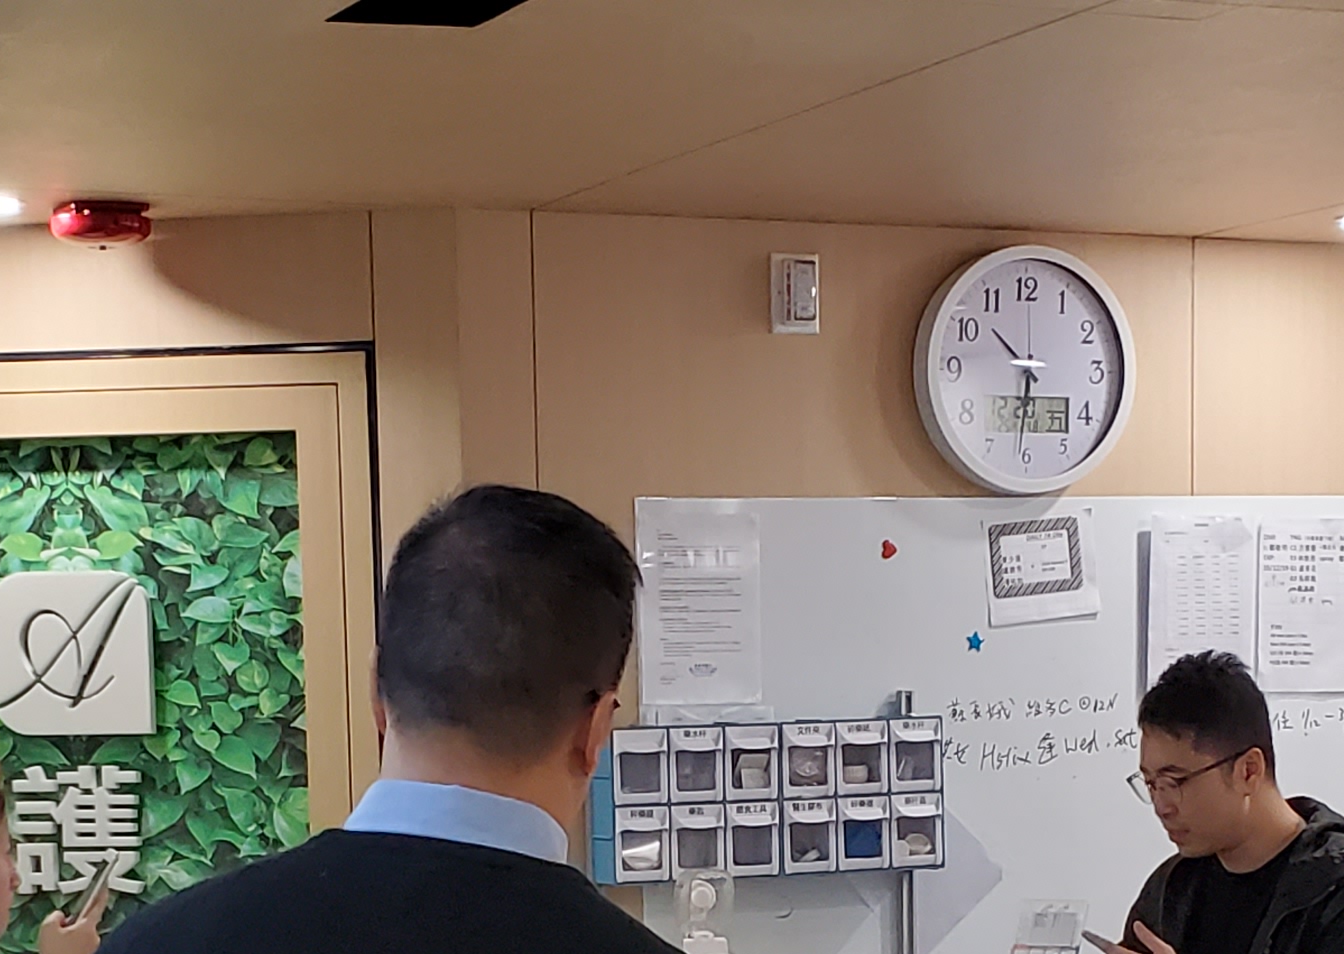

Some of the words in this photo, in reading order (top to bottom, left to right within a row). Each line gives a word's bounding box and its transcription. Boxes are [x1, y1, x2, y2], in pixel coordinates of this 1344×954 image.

[984, 288, 1000, 313] 11
[1016, 277, 1038, 302] 12
[1058, 290, 1066, 314] 1
[958, 317, 979, 342] 10
[1081, 320, 1095, 344] 2
[947, 356, 962, 382] 9
[1089, 360, 1105, 384] 3
[959, 399, 974, 425] 8
[1077, 400, 1093, 426] 4
[985, 438, 995, 454] 7
[1022, 447, 1031, 465] 6
[1058, 438, 1068, 455] 5
[11, 764, 146, 895] 護
